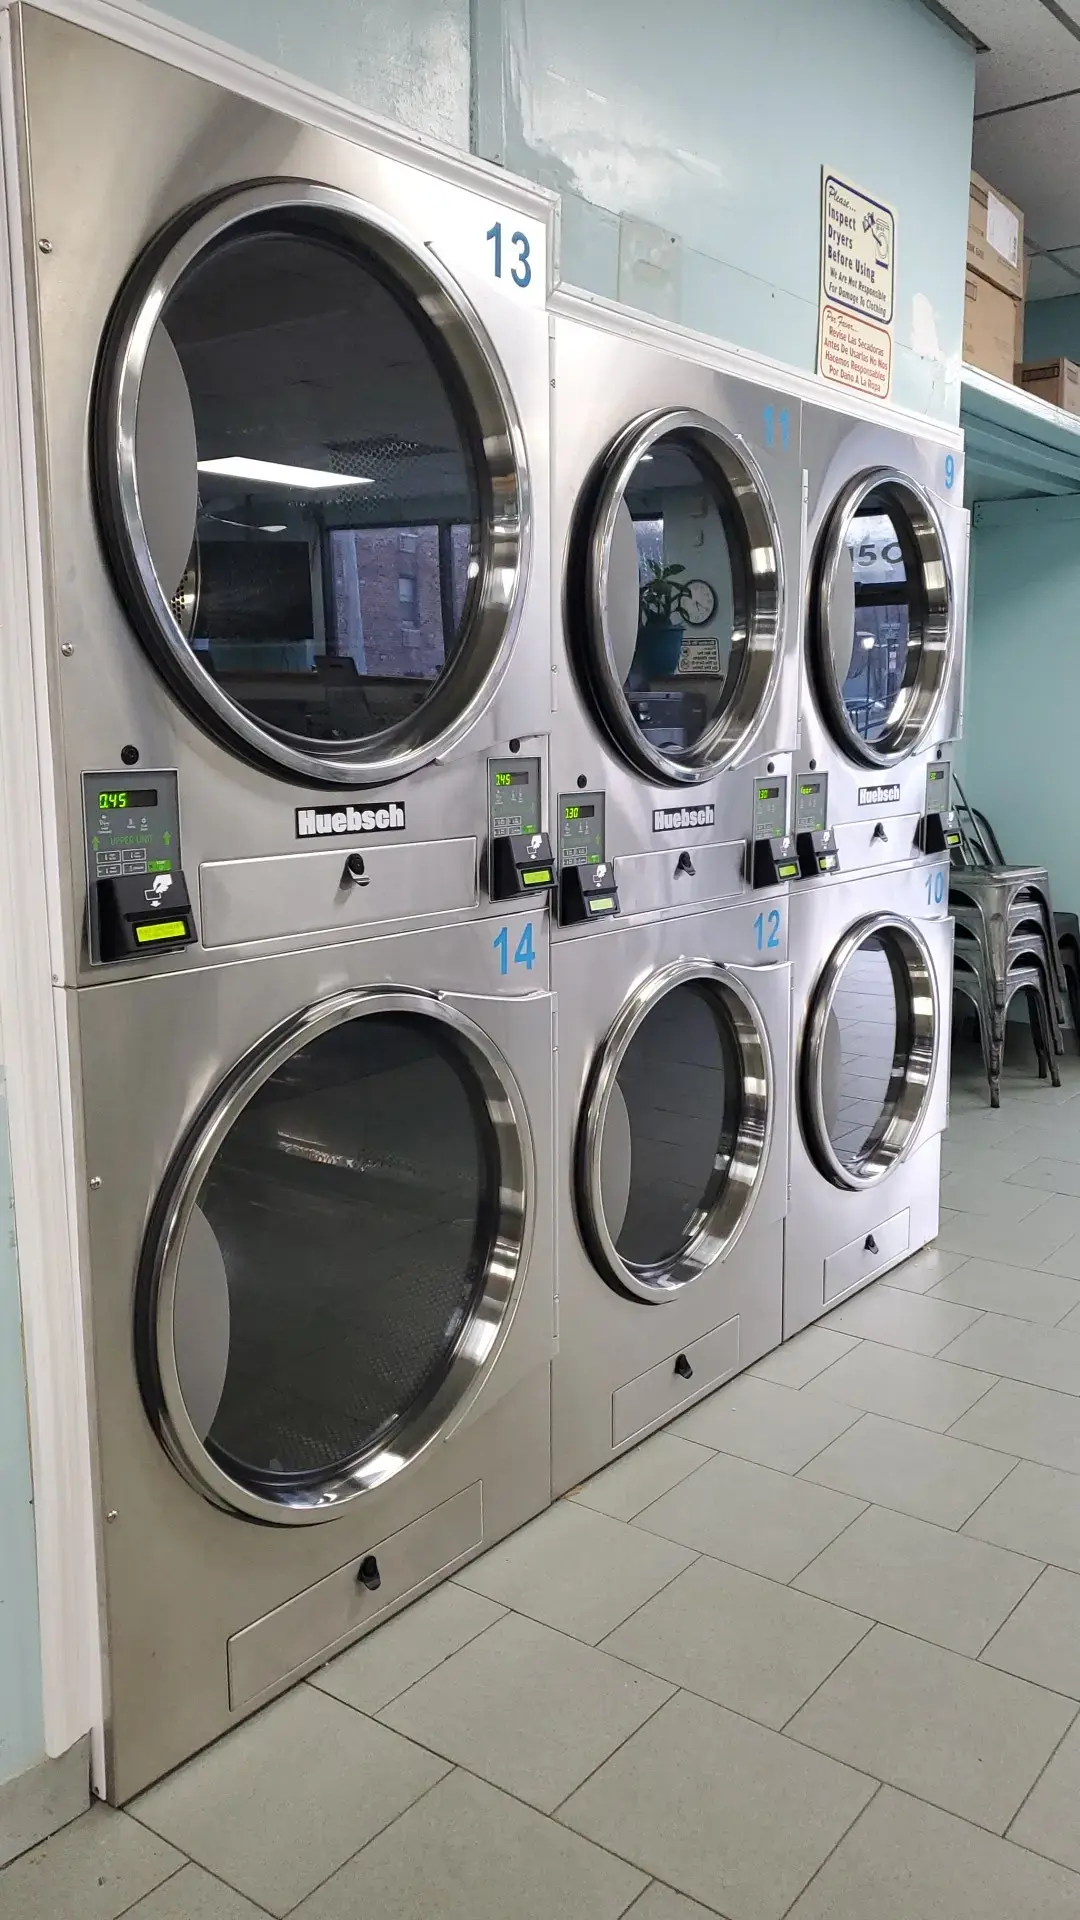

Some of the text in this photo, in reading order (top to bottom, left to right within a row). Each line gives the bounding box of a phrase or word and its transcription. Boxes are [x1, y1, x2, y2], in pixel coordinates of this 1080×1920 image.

[828, 202, 856, 231] Inspect
[828, 223, 853, 250] Dryers
[487, 221, 531, 288] 13
[827, 244, 875, 284] Before Using
[829, 281, 887, 318] For Damage To Clothing
[830, 267, 887, 302] We Are Not Responsible
[824, 337, 888, 371] Antes De Usarlas No Nos
[829, 325, 884, 357] Revise Las Secadoras
[825, 350, 886, 382] Hacemos Responsables
[829, 365, 839, 377] Por
[855, 375, 860, 385] A
[860, 376, 867, 387] La
[868, 381, 881, 393] Ropa
[763, 404, 789, 452] 11
[945, 454, 954, 489] 9
[859, 785, 900, 804] Huebsch
[297, 803, 404, 835] Huebsch
[654, 805, 714, 831] Huebsch
[925, 871, 943, 905] 10
[753, 909, 780, 951] 12
[493, 922, 536, 976] 14
